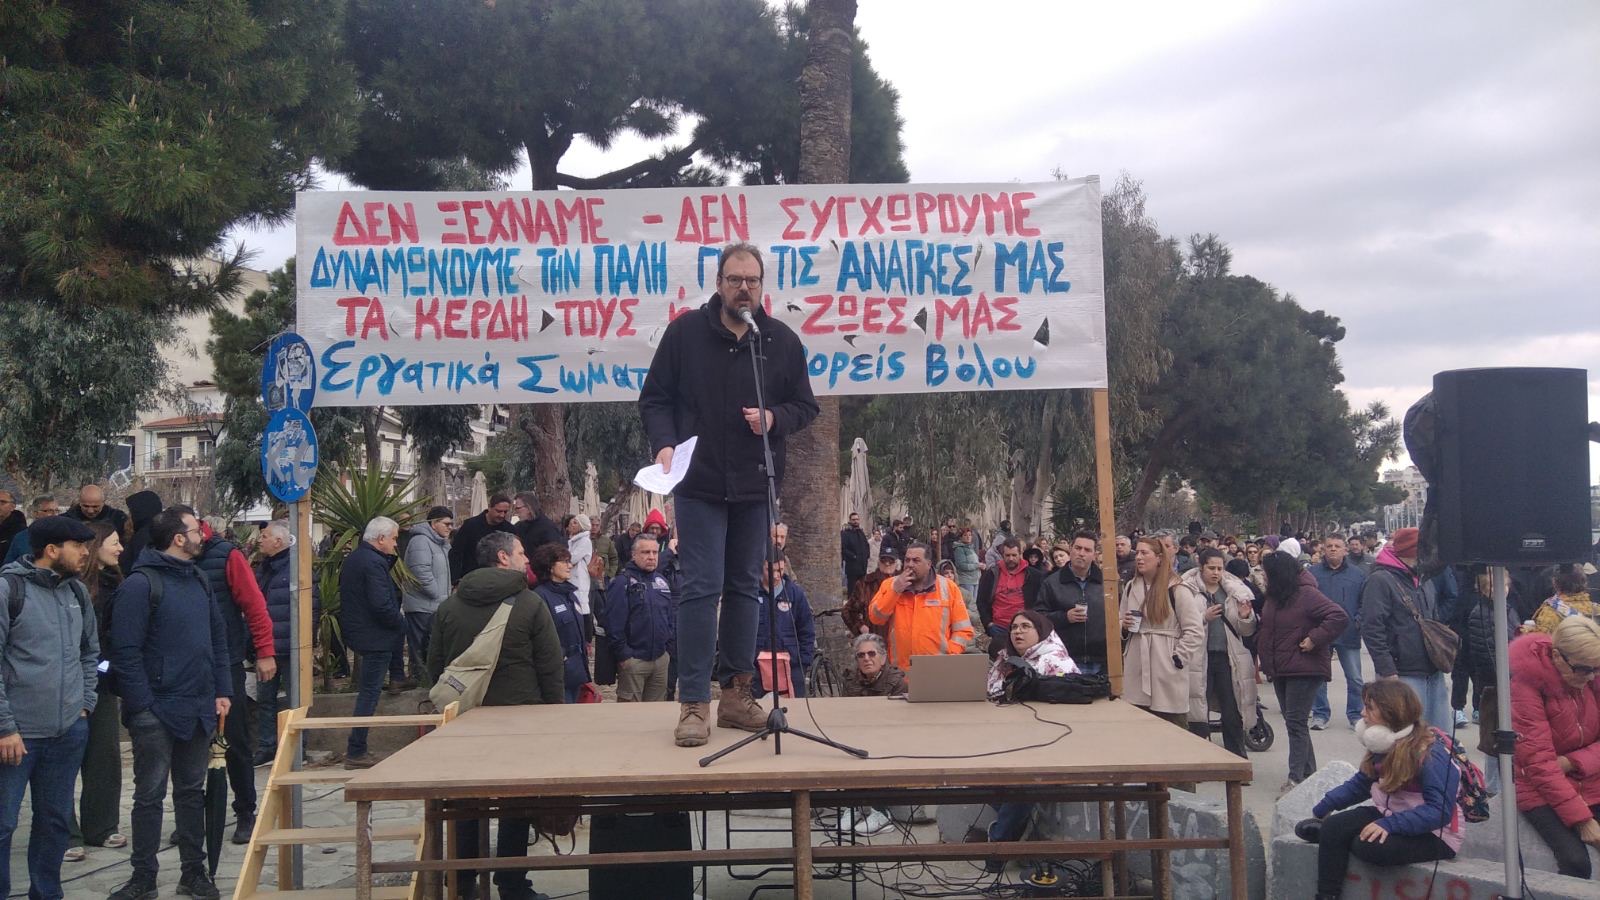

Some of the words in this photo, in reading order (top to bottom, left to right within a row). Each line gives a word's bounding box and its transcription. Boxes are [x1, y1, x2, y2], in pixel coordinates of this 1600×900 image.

[333, 201, 420, 246] ΔΕΝ
[437, 197, 609, 246] ΞΕΧΝΑΜΕ
[675, 193, 750, 245] ΔΕΝ
[779, 192, 1041, 241] ΣΥΓΧΩΡΟΥΜΕ
[309, 246, 521, 298] ΔΥΝΑΜΩΝΟΥΜΕ
[536, 247, 581, 294] ΤΗΝ
[592, 241, 668, 296] ΠΑΛΗ
[770, 245, 820, 290] ΤΙΣ
[836, 240, 973, 296] ΑΝΑΓΚΕΣ
[994, 240, 1071, 294] ΜΑΣ
[336, 297, 389, 341] ΤΑ
[414, 295, 529, 342] ΚΕΡΔΗ
[554, 298, 640, 340] ΤΟΥΣ
[801, 294, 907, 336] ΖΩΕΣ
[934, 292, 1022, 341] ΜΑΣ
[516, 353, 649, 397] Σωματ
[802, 343, 905, 389] ορείς
[926, 342, 1037, 388] Βόλου
